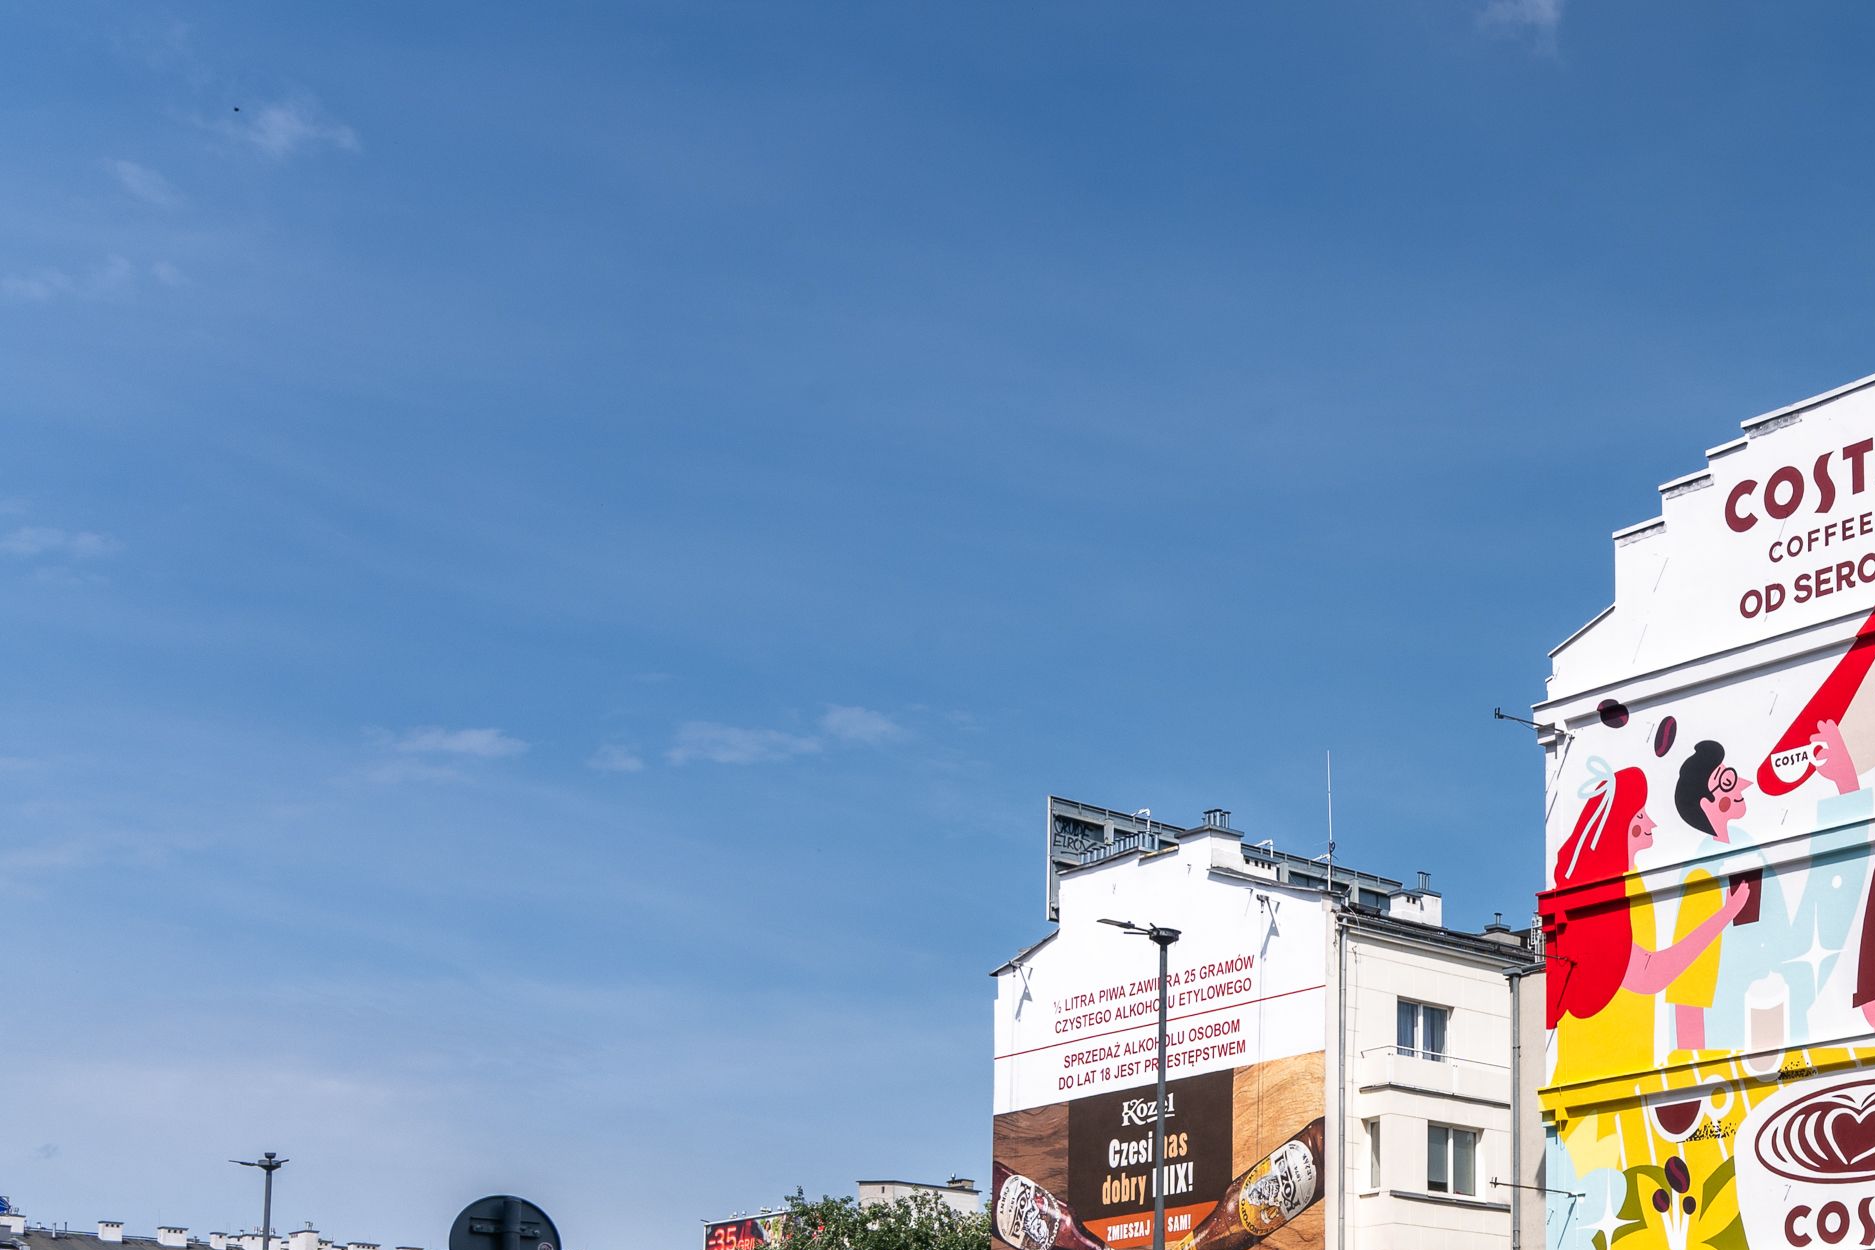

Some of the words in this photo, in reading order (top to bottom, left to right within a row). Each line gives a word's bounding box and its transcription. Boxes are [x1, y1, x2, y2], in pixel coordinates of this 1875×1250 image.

[1769, 511, 1873, 563] COFFEE
[1740, 583, 1786, 619] OD
[1775, 751, 1808, 768] COSTA
[1055, 1008, 1112, 1034] CZYSTEGO
[1114, 995, 1175, 1021] ALKOHOU
[1179, 977, 1252, 1006] ETYLOWEGO
[1064, 992, 1095, 1012] LITRA
[1099, 985, 1126, 1003] PIWA
[1129, 972, 1181, 996] ZAWIRA
[1184, 969, 1196, 984] 25
[1199, 955, 1255, 980] GRAMÓW
[1058, 1075, 1074, 1090] DO
[1077, 1071, 1097, 1087] LAT
[1100, 1068, 1111, 1082] 18
[1114, 1061, 1141, 1079] JEST
[1144, 1039, 1247, 1072] PRESTĘPSTWEM
[1064, 1041, 1121, 1069] SPRZEDAŻ
[1188, 1018, 1241, 1042] OSOBOM
[1108, 1131, 1152, 1168] Czesi
[1102, 1172, 1147, 1205] dobry
[1106, 1219, 1151, 1242] ZMIESZAJ
[1167, 1213, 1192, 1233] SAM!
